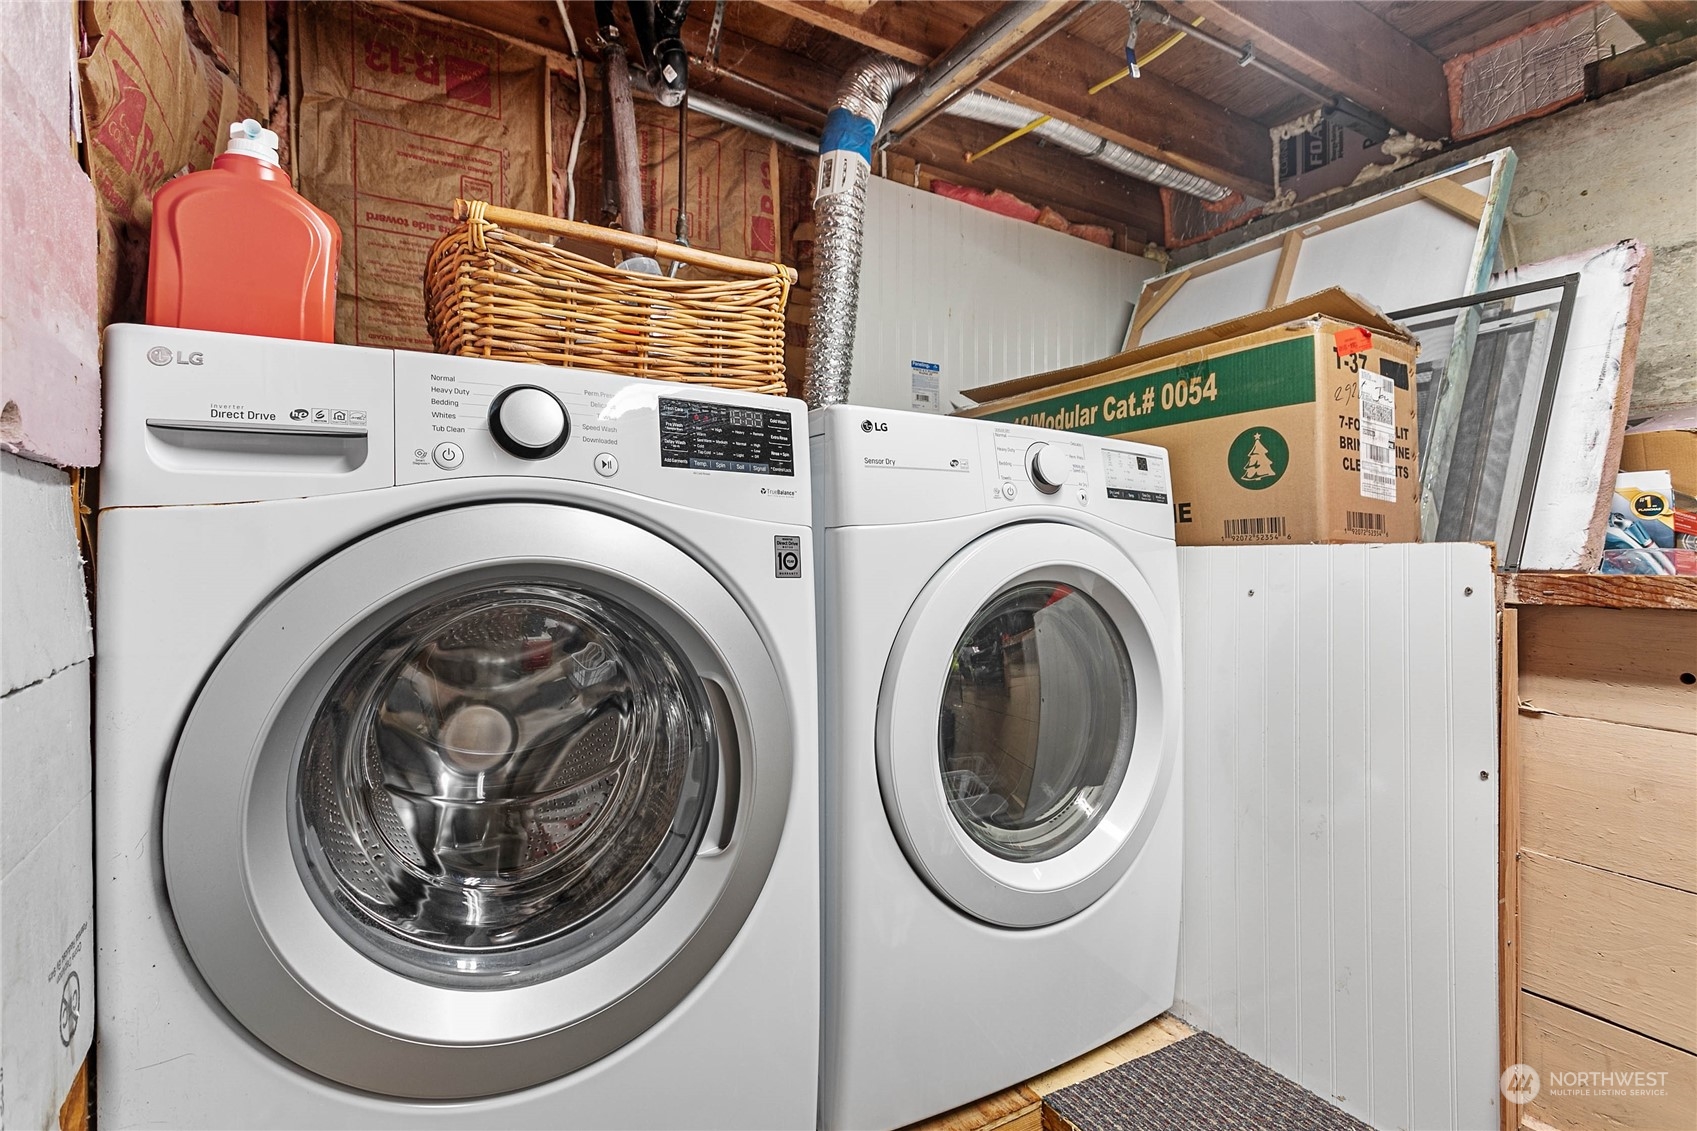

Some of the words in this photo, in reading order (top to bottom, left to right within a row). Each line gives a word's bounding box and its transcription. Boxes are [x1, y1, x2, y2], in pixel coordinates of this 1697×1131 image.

[363, 41, 440, 87] R-13
[639, 130, 649, 163] toward
[1309, 125, 1323, 166] FOA
[366, 212, 409, 227] toward
[412, 220, 435, 232] side
[176, 350, 204, 366] LG
[430, 374, 456, 382] Normal
[430, 386, 453, 394] Heavy
[454, 387, 470, 396] Duty
[1103, 386, 1155, 421] Cat.#
[1160, 372, 1218, 410] 0054
[431, 398, 459, 407] Bedding
[210, 408, 245, 420] Direct
[247, 410, 276, 421] Drive
[431, 411, 456, 419] Whites
[432, 424, 445, 432] Tub
[446, 425, 465, 433] Clean
[582, 423, 600, 431] Speed
[601, 425, 618, 433] Wash
[874, 422, 888, 432] LG
[582, 436, 618, 445] Downloaded
[864, 457, 884, 465] Sensor
[885, 458, 896, 466] Dry
[1231, 534, 1253, 542] 92072
[1256, 533, 1279, 541] 52354
[777, 551, 799, 571] 10
